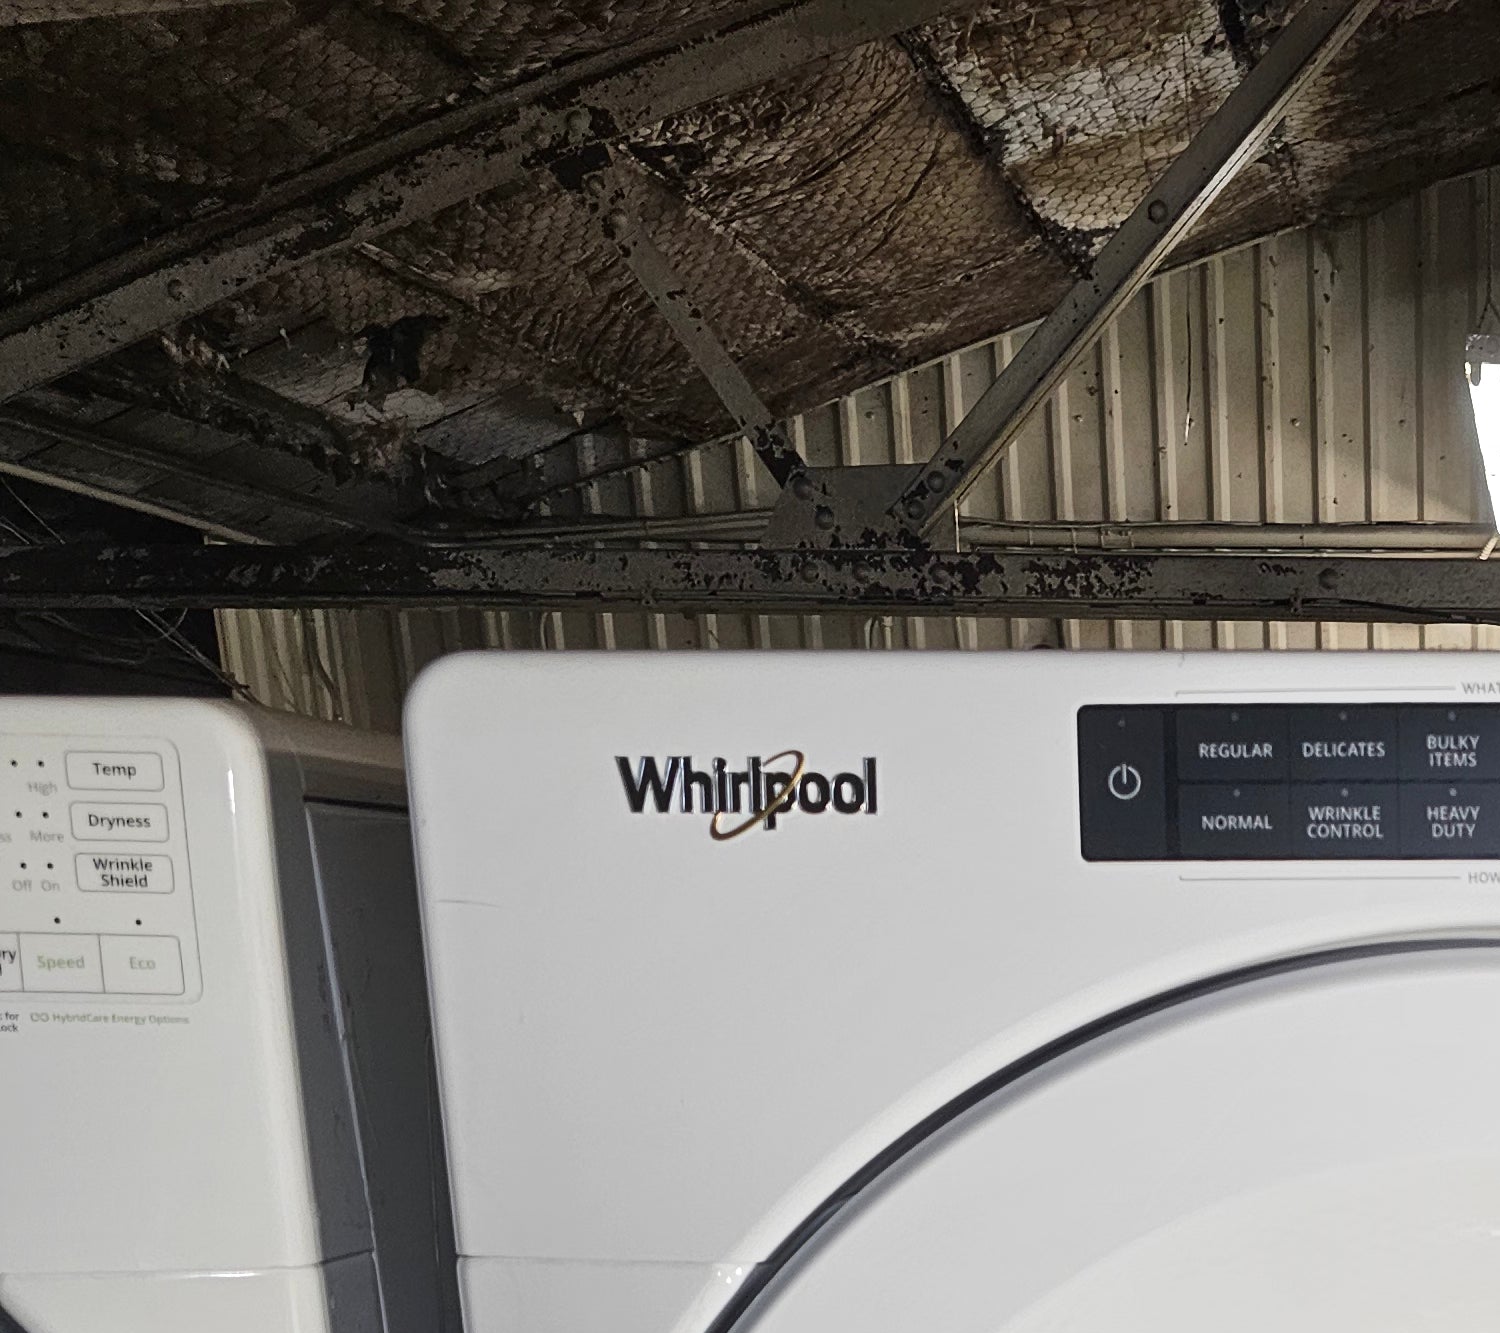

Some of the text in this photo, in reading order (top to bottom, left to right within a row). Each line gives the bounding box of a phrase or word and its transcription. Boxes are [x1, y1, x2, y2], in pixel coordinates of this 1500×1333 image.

[1199, 742, 1273, 759] REGULAR
[1302, 741, 1386, 758] DELICATES
[1426, 734, 1481, 751] BULKY
[1428, 752, 1478, 768] ITEMS
[92, 762, 138, 779] Temp
[27, 781, 58, 797] High
[614, 752, 878, 834] Whirlpool
[1308, 805, 1381, 821] WRINKLE
[1426, 805, 1481, 822] HEAVY
[87, 813, 152, 831] Dryness
[1201, 815, 1273, 831] NORMAL
[29, 830, 65, 843] More
[1307, 823, 1384, 839] CONTROL
[1431, 822, 1477, 839] DUTY
[92, 858, 154, 873] Wrinkle
[12, 879, 33, 892] Off
[41, 879, 61, 892] On
[101, 874, 149, 889] Shield
[0, 950, 17, 964] ry
[36, 954, 86, 971] Speed
[128, 956, 157, 971] Eco
[5, 1011, 20, 1022] for
[52, 1012, 191, 1026] HybridCare Energy Options
